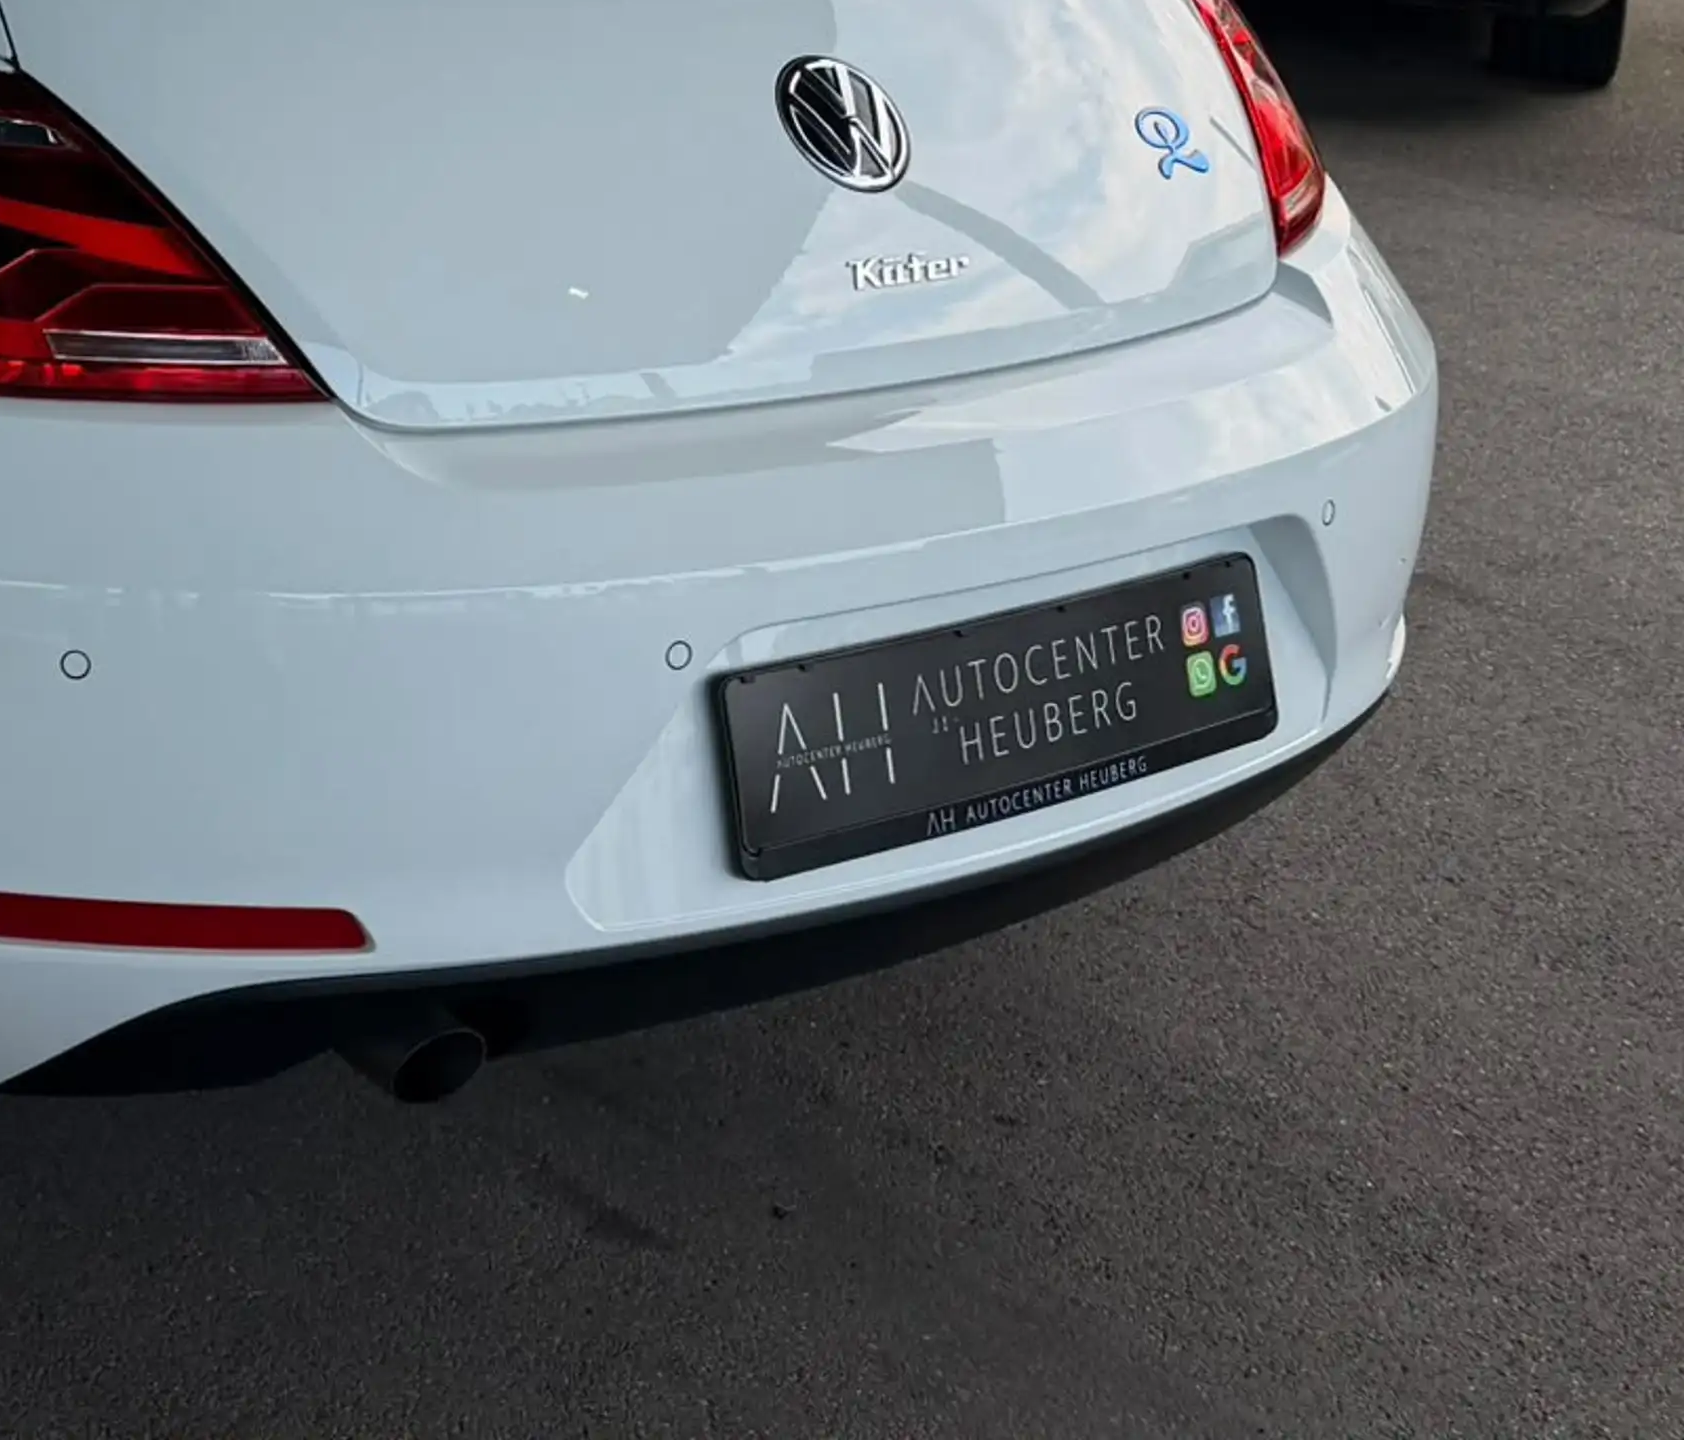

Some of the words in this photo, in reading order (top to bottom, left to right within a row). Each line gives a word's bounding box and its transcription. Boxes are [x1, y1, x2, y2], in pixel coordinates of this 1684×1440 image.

[913, 615, 1165, 716] AUTOCENTER
[959, 682, 1137, 766] HEUBERG
[927, 811, 958, 836] AH
[966, 778, 1073, 825] AUTOCENTER
[1079, 756, 1148, 791] HEUBERG
